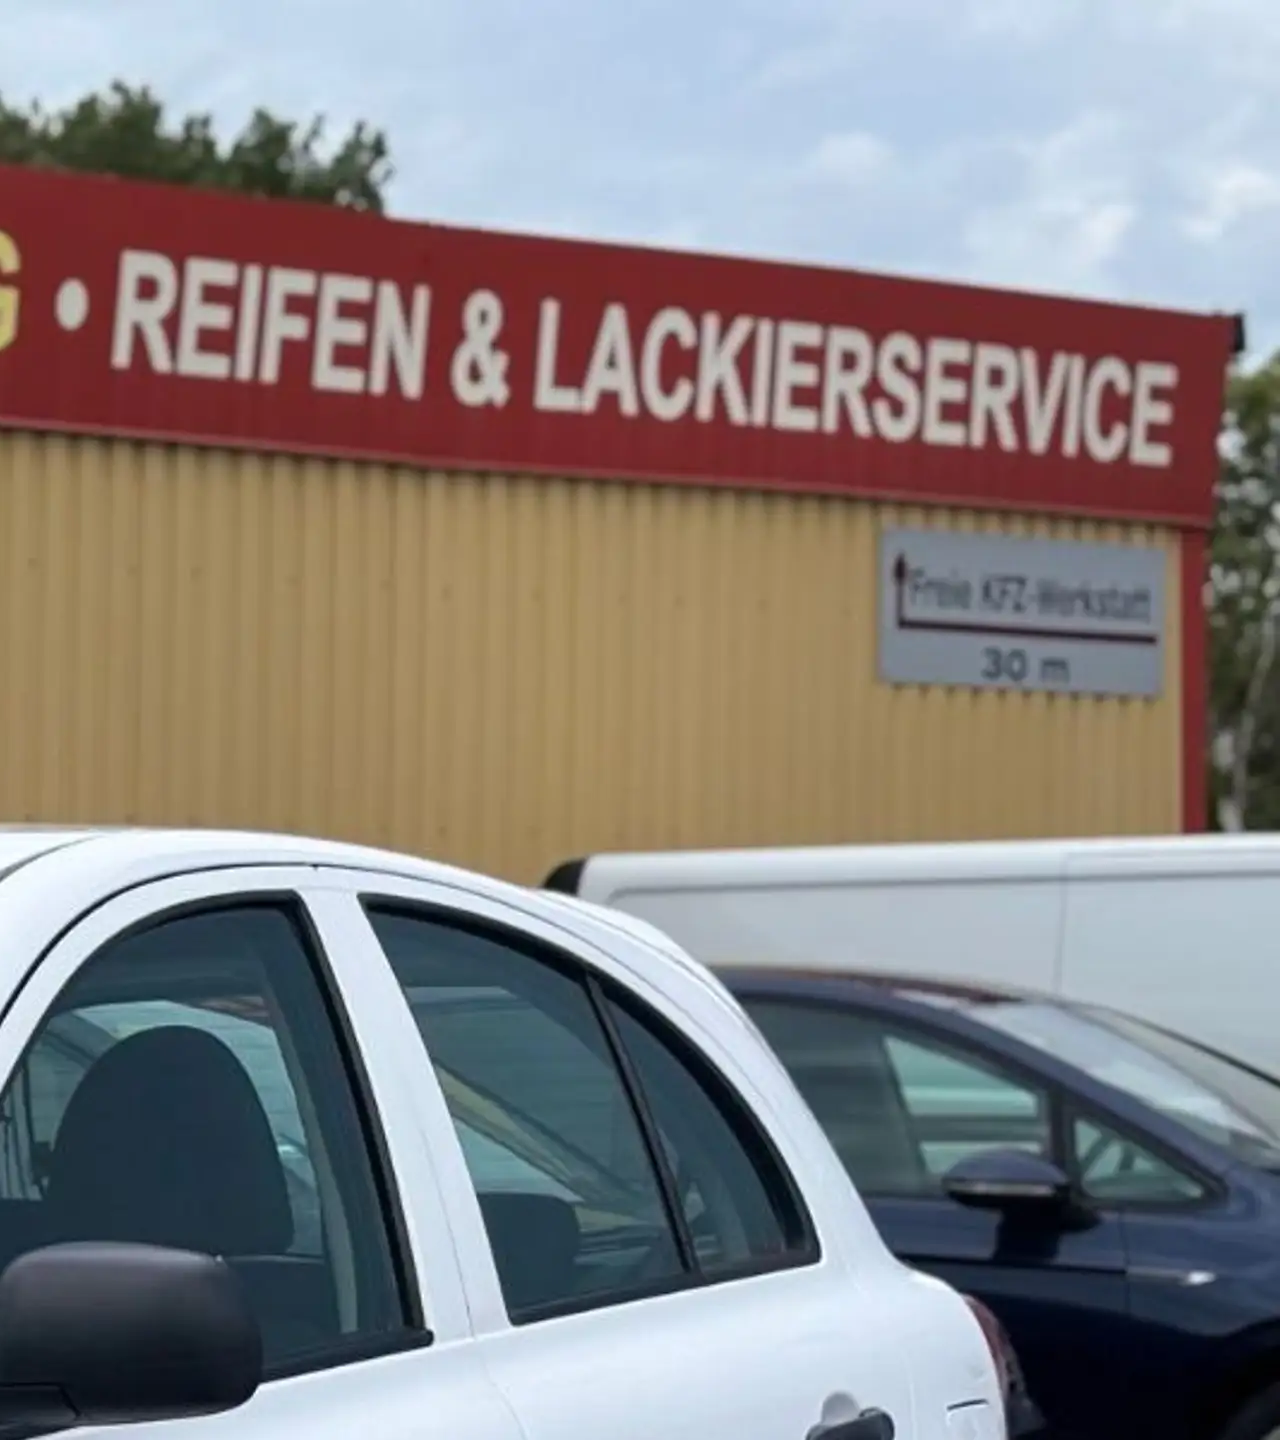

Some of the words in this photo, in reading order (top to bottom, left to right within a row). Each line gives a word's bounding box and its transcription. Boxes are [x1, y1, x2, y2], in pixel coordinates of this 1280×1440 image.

[110, 248, 431, 400] REIFEN
[450, 288, 511, 407] &
[532, 297, 1178, 467] LACKIERSERVICE
[981, 647, 1029, 682] 30
[1041, 658, 1071, 684] m
